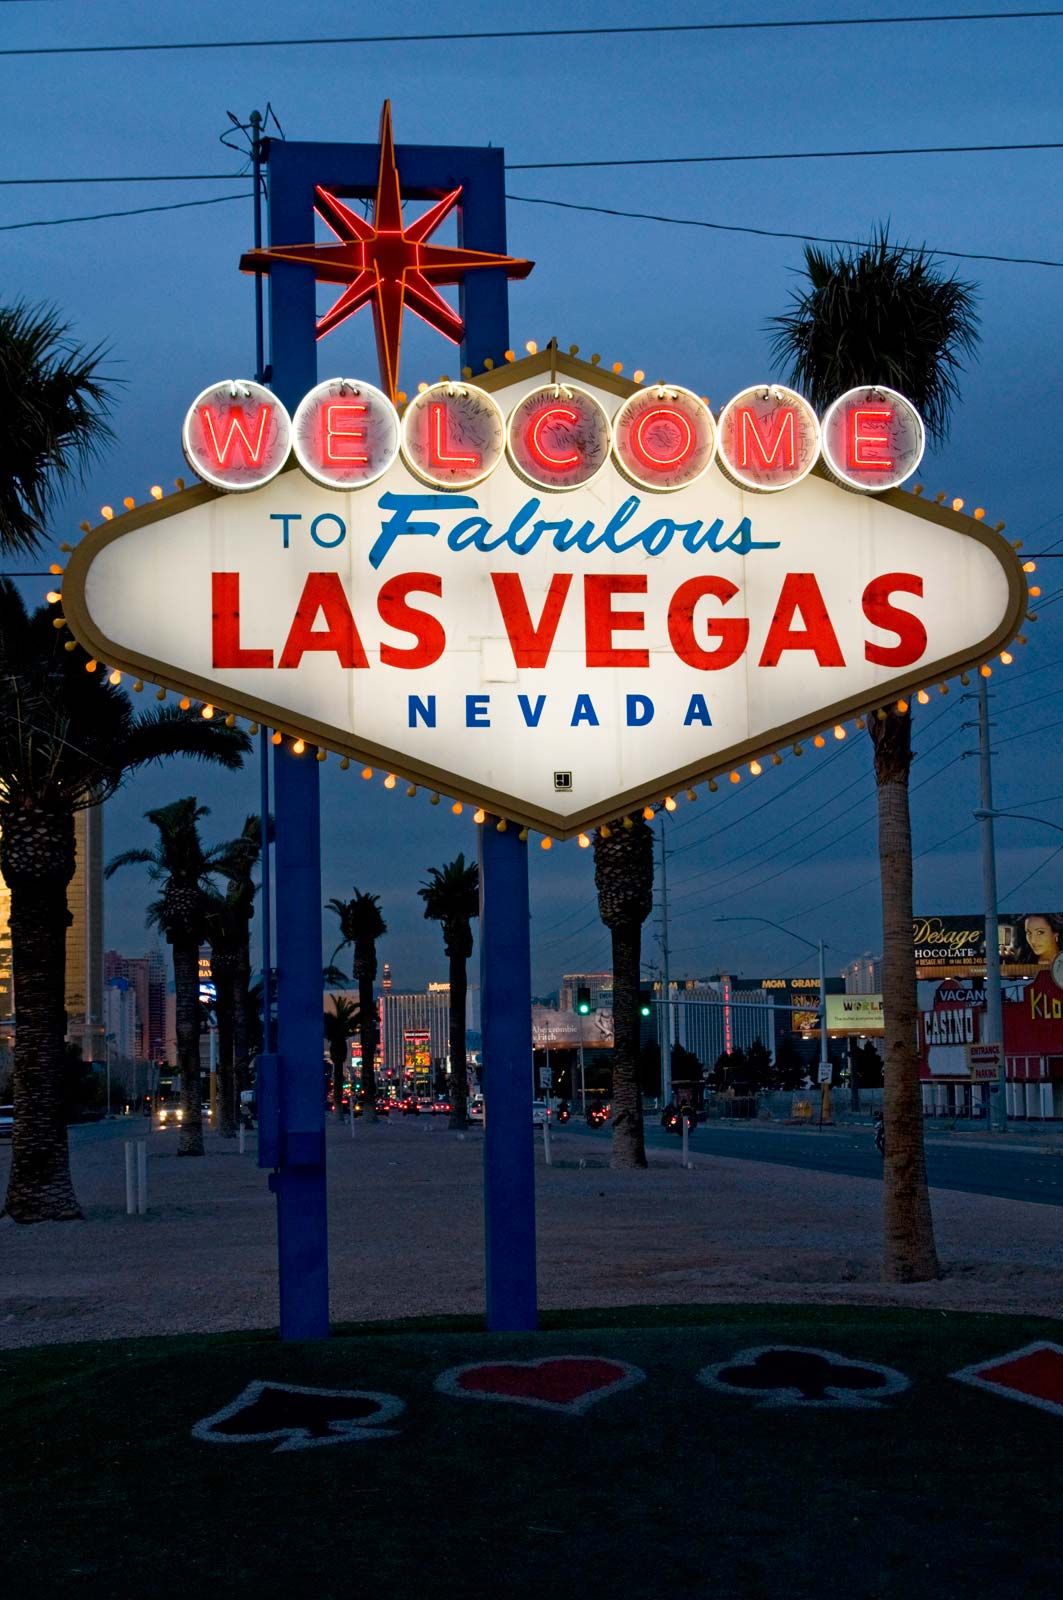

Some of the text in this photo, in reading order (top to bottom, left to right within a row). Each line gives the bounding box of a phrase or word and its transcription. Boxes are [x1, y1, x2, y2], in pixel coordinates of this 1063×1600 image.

[197, 404, 895, 472] WELCOME
[270, 492, 780, 570] TO Fabulous
[212, 572, 928, 670] LAS VEGAS
[408, 693, 712, 728] NEVADA
[913, 917, 981, 950] Desage
[914, 948, 976, 958] HOCOLATE
[653, 981, 679, 990] MM
[762, 979, 786, 989] MGM
[939, 989, 989, 1001] VACAN
[924, 1008, 973, 1045] CASINO
[971, 1046, 999, 1055] ENTRANCE
